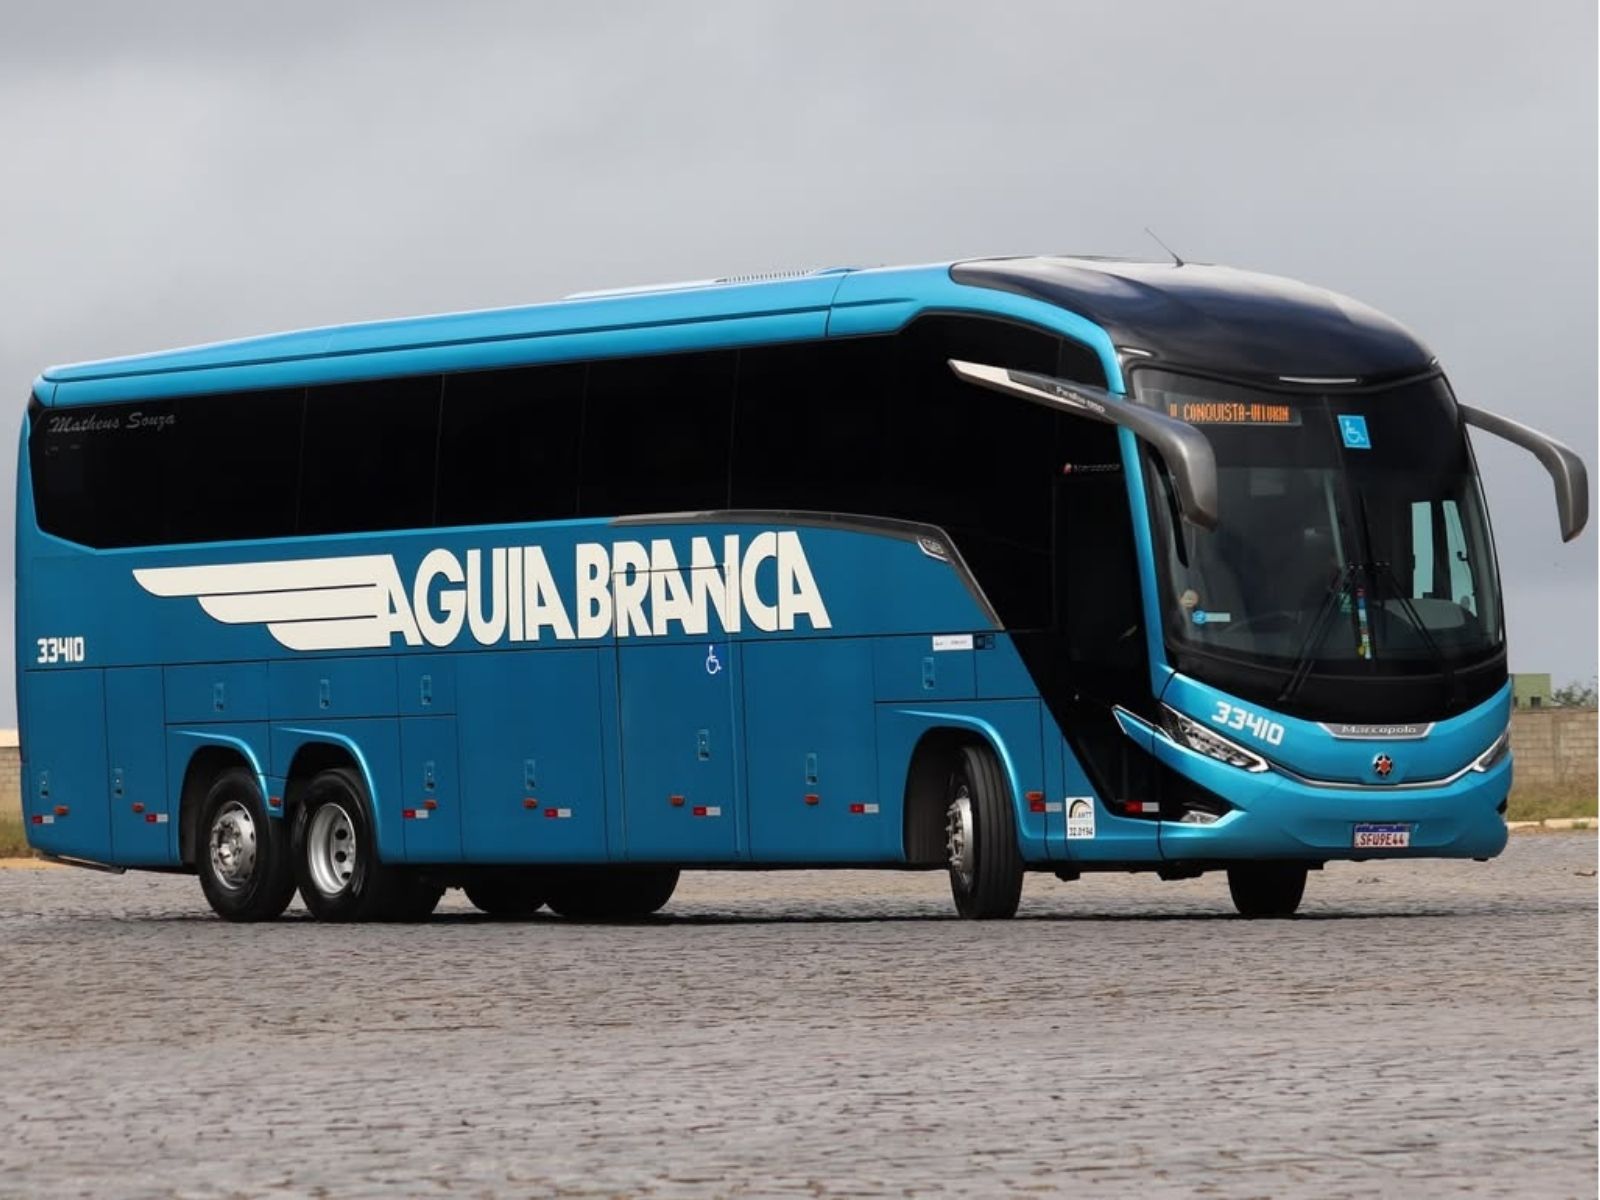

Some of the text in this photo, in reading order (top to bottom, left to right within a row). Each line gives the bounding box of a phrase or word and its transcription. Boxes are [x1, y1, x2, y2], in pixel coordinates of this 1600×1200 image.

[375, 531, 833, 648] AGUIA BRANCA
[37, 636, 85, 663] 33410
[1211, 700, 1285, 746] 33410
[1341, 725, 1417, 734] Marcopolo
